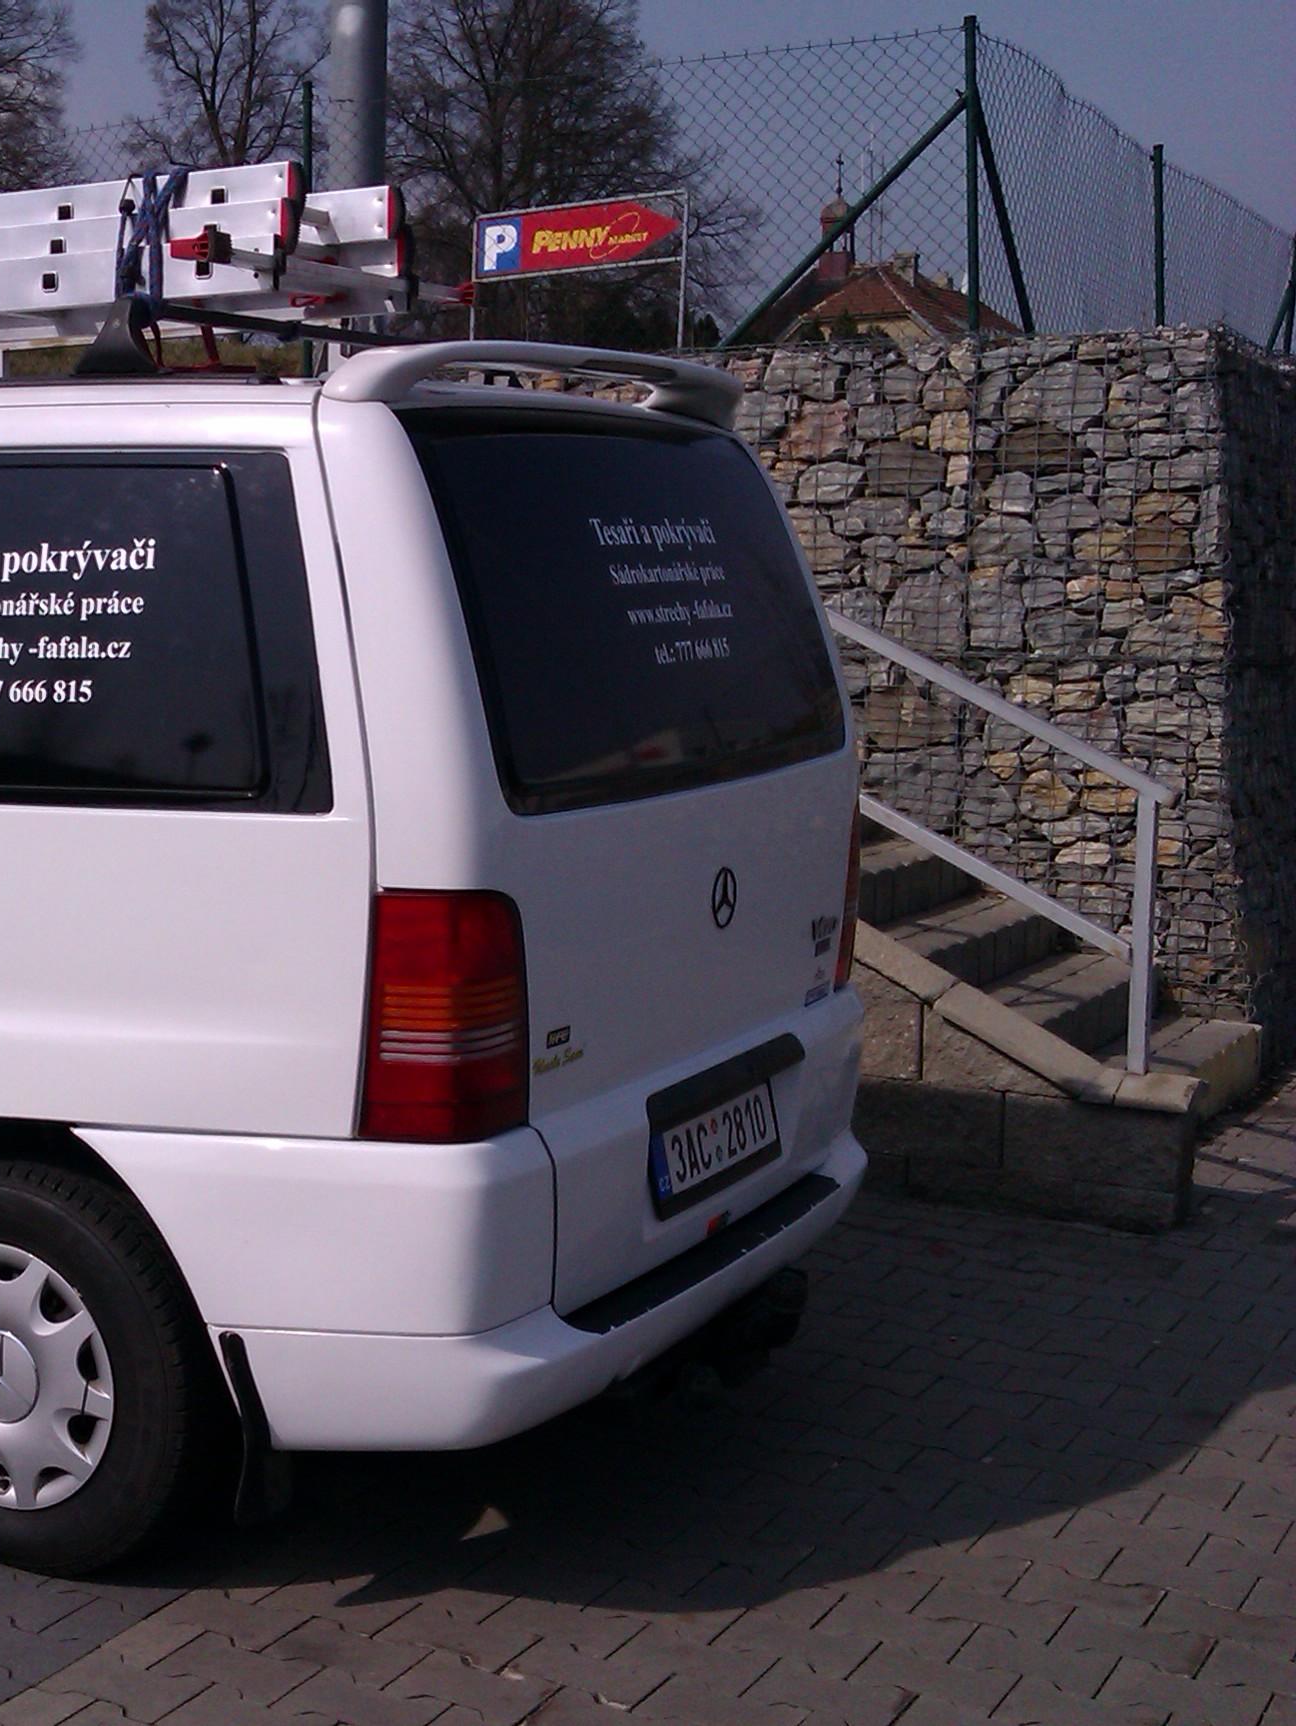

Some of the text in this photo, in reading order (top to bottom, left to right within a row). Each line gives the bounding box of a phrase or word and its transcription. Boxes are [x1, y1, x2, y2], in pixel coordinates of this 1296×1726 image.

[484, 224, 518, 271] P
[532, 226, 649, 254] PENNY MARKET
[589, 517, 716, 551] Tesaři a pokrývači
[1, 538, 156, 582] pokrývači
[80, 591, 144, 621] práce
[28, 636, 132, 660] -fafala.cz
[675, 640, 694, 662] 777
[695, 638, 711, 661] 666
[711, 636, 730, 659] 815
[9, 680, 47, 704] 666
[53, 680, 93, 703] 815
[671, 1093, 767, 1184] 3AC 2810
